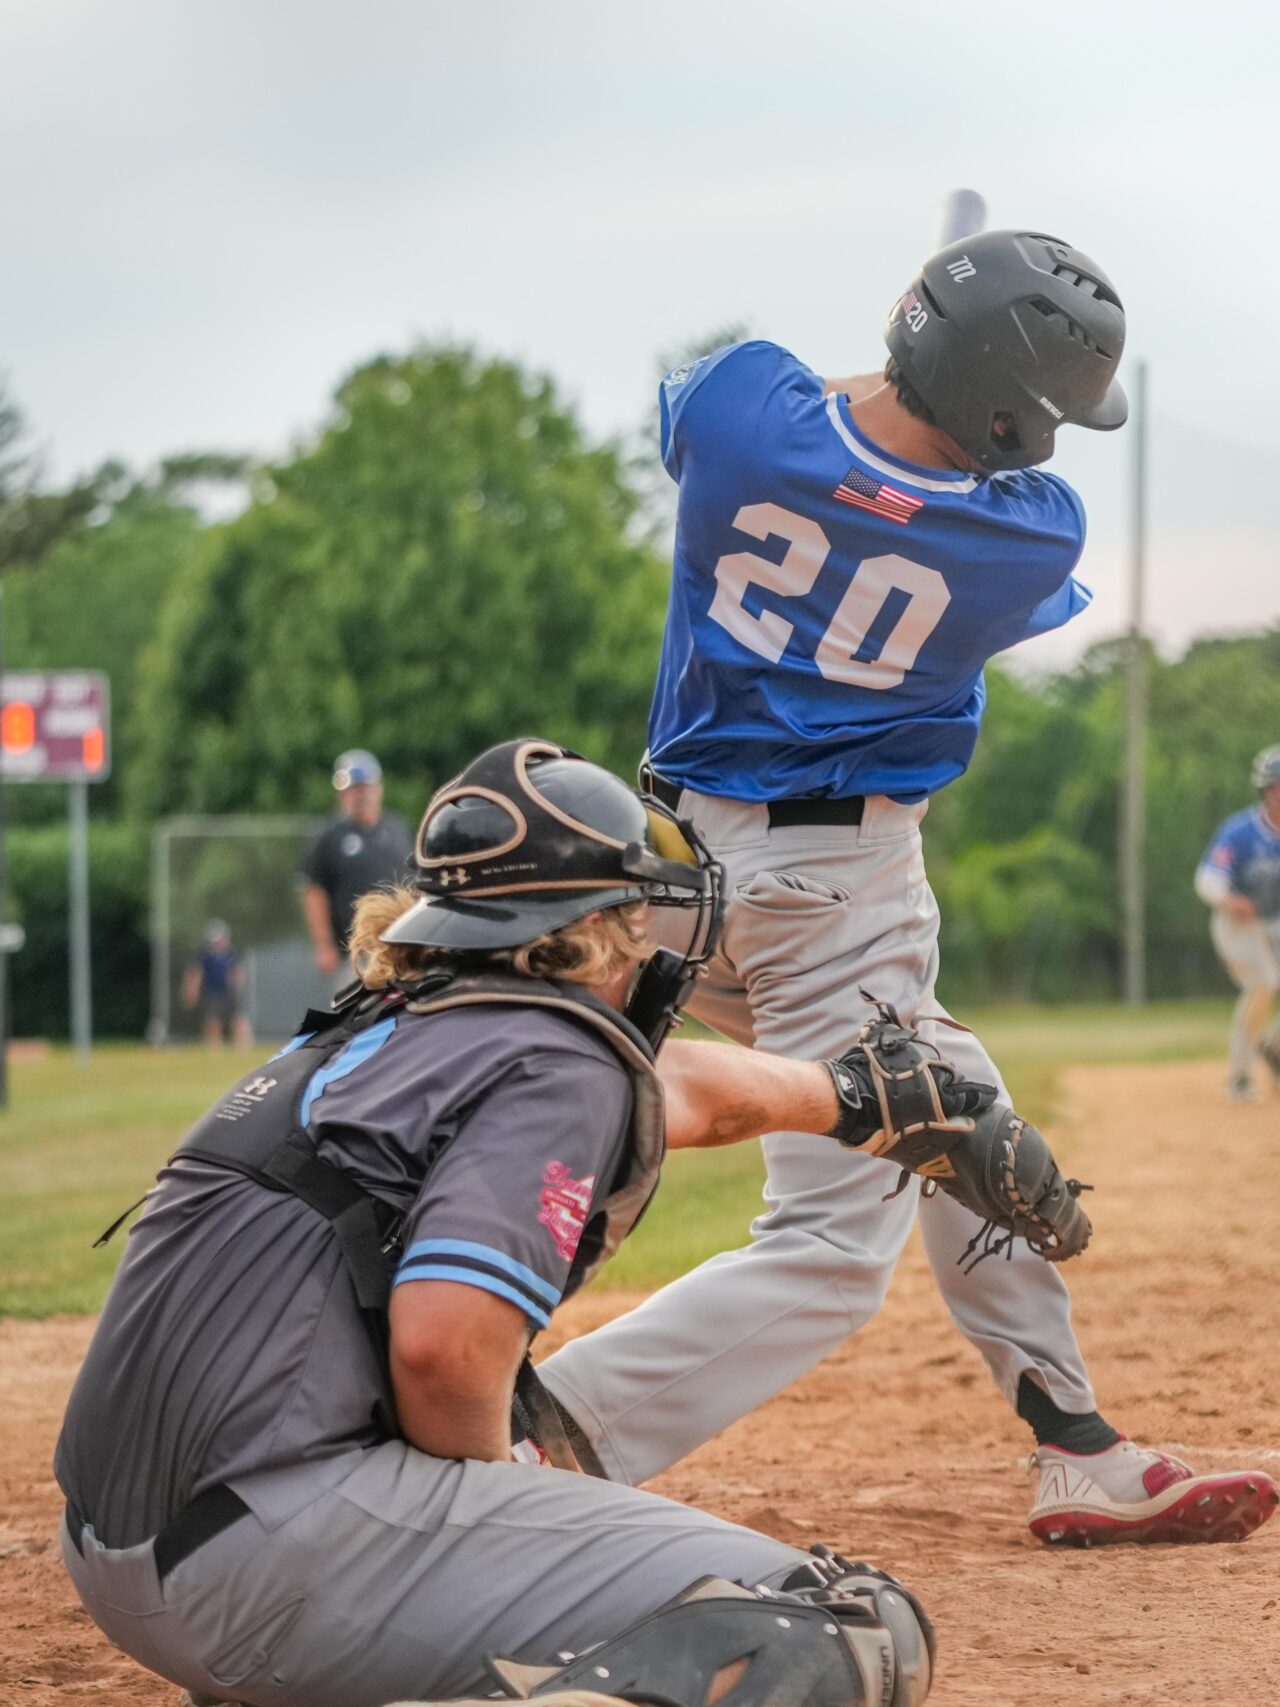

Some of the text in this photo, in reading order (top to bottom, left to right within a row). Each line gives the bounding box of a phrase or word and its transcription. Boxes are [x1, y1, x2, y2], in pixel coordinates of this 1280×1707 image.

[905, 301, 928, 333] 20
[1040, 396, 1064, 419] marucci
[707, 502, 952, 690] 20
